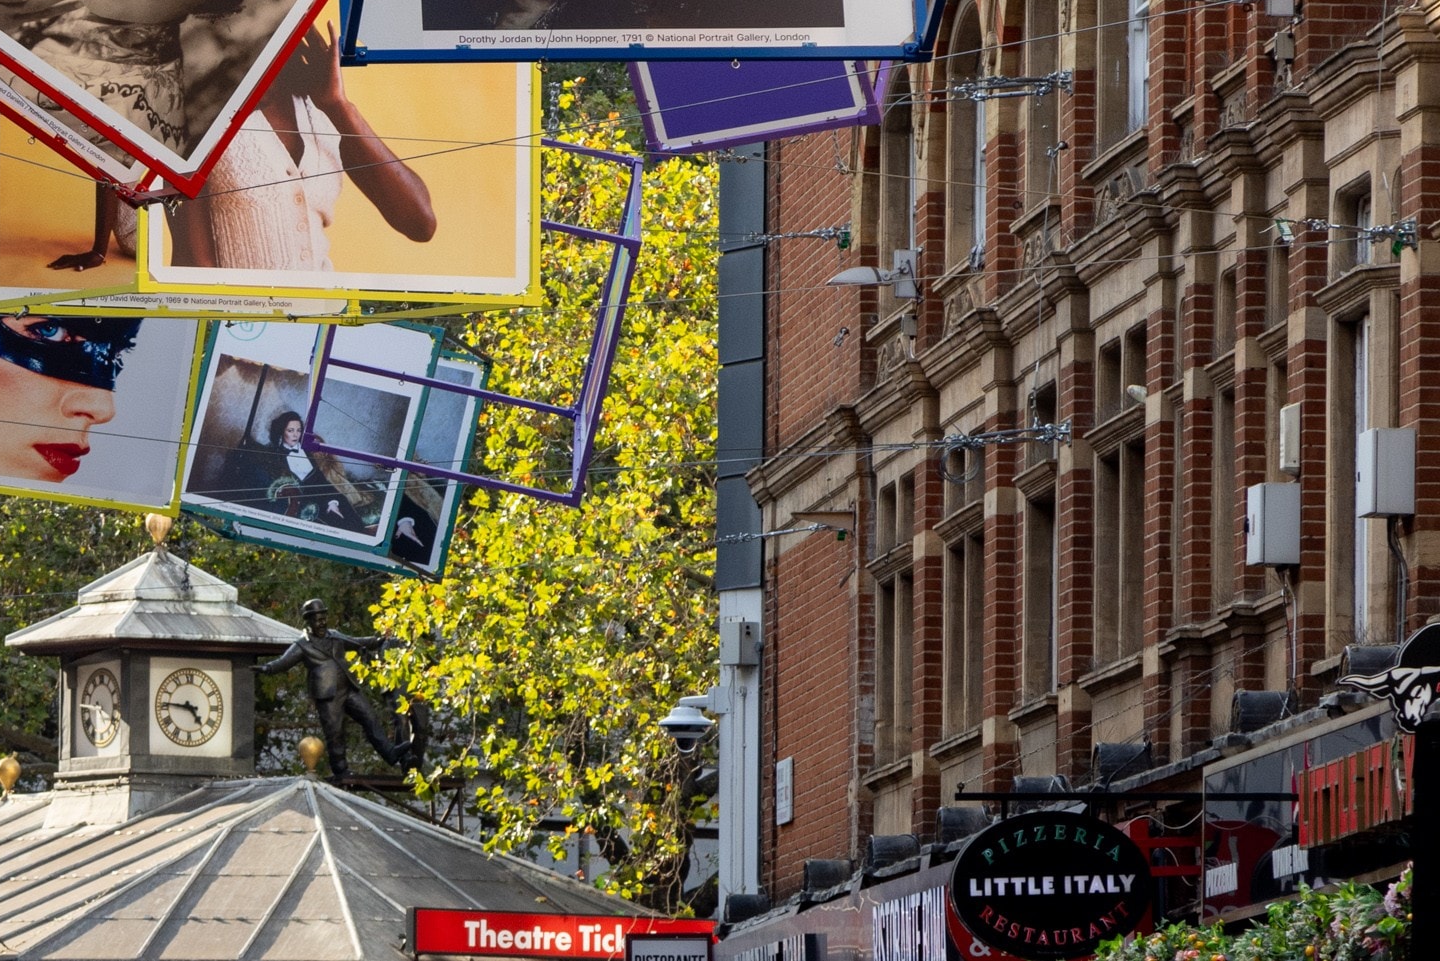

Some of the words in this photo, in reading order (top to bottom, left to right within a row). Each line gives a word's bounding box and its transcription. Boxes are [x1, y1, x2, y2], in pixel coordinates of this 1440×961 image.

[459, 35, 496, 45] Dorothy
[535, 35, 546, 44] by
[575, 34, 618, 44] Hoppner,
[622, 34, 641, 42] 1791
[699, 33, 733, 41] Portrait
[736, 33, 771, 43] Gallery,
[775, 32, 809, 40] London
[5, 91, 25, 107] Daniels
[27, 106, 49, 123] National
[48, 120, 68, 136] Portrait
[65, 133, 87, 151] Gallery,
[85, 146, 106, 163] London
[100, 294, 107, 302] by
[129, 296, 164, 304] Wedgbury,
[243, 300, 266, 308] Gallery,
[981, 824, 1121, 865] PIZZERIA
[969, 876, 1055, 897] LITTLE
[1064, 874, 1135, 895] ITALY
[464, 919, 572, 951] Theatre
[578, 924, 640, 953] Tick
[978, 901, 1130, 946] RESTAURANT
